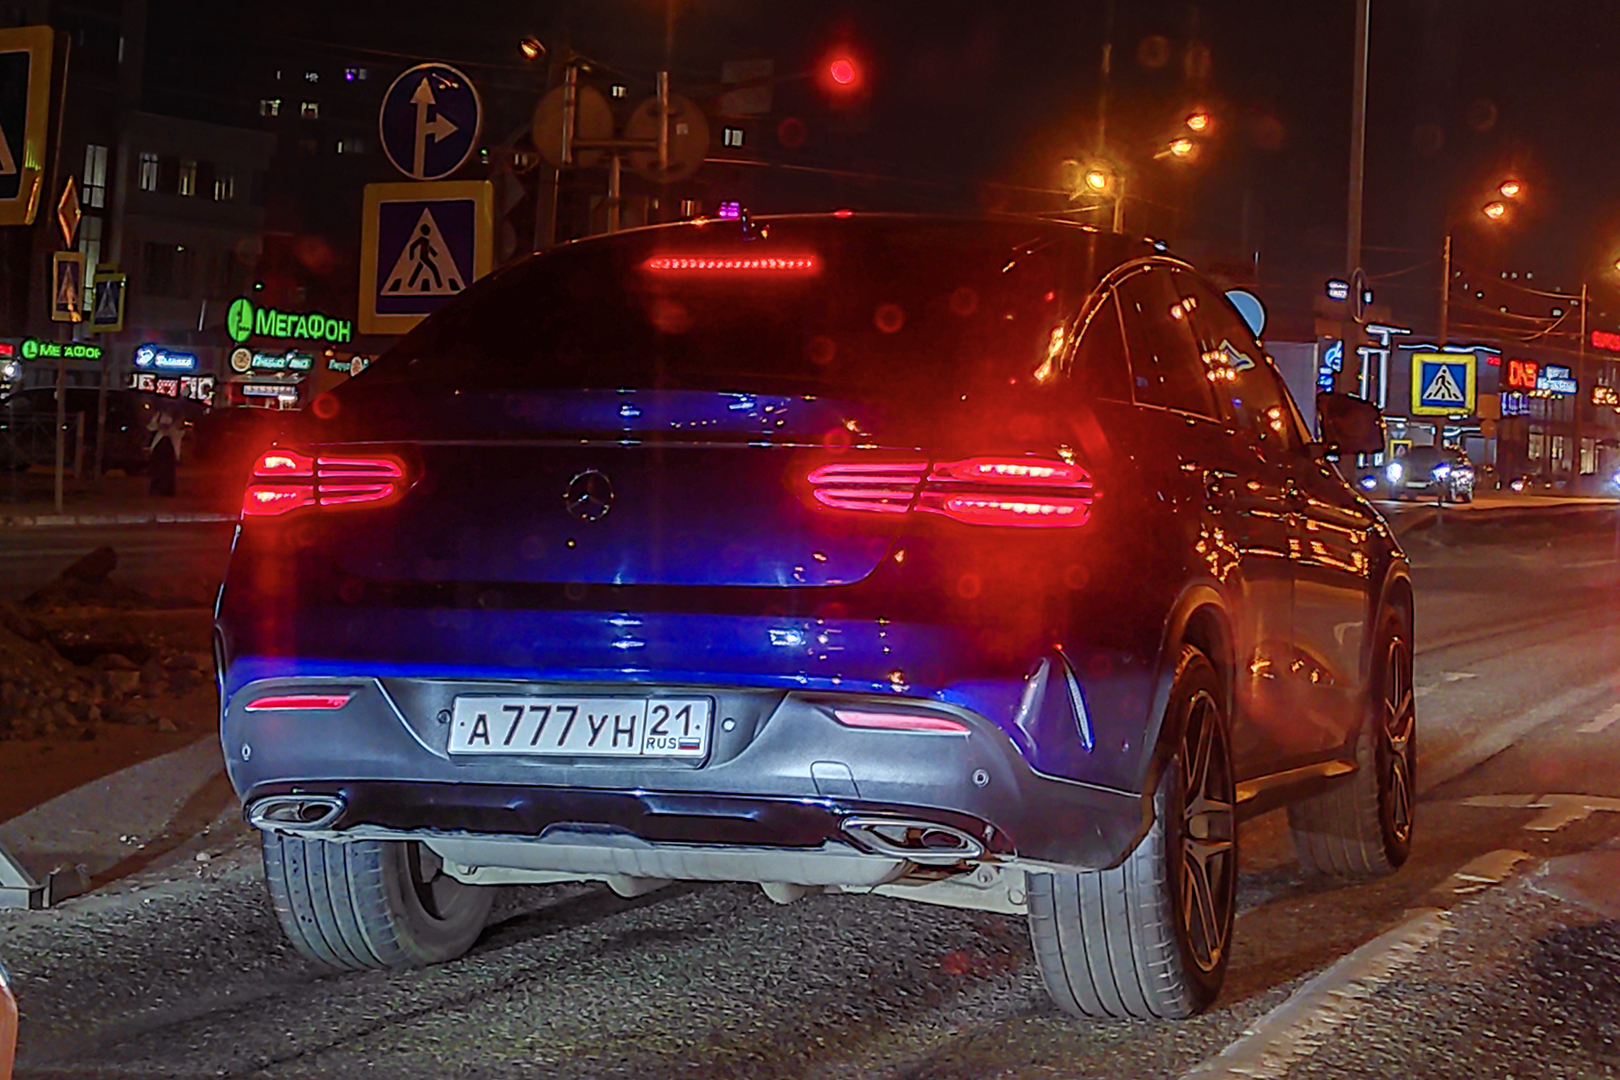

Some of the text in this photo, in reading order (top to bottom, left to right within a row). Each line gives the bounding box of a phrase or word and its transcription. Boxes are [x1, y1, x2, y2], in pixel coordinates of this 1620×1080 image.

[255, 308, 351, 342] МЕГАФОН
[650, 704, 692, 736] 21
[646, 737, 677, 750] RUS
